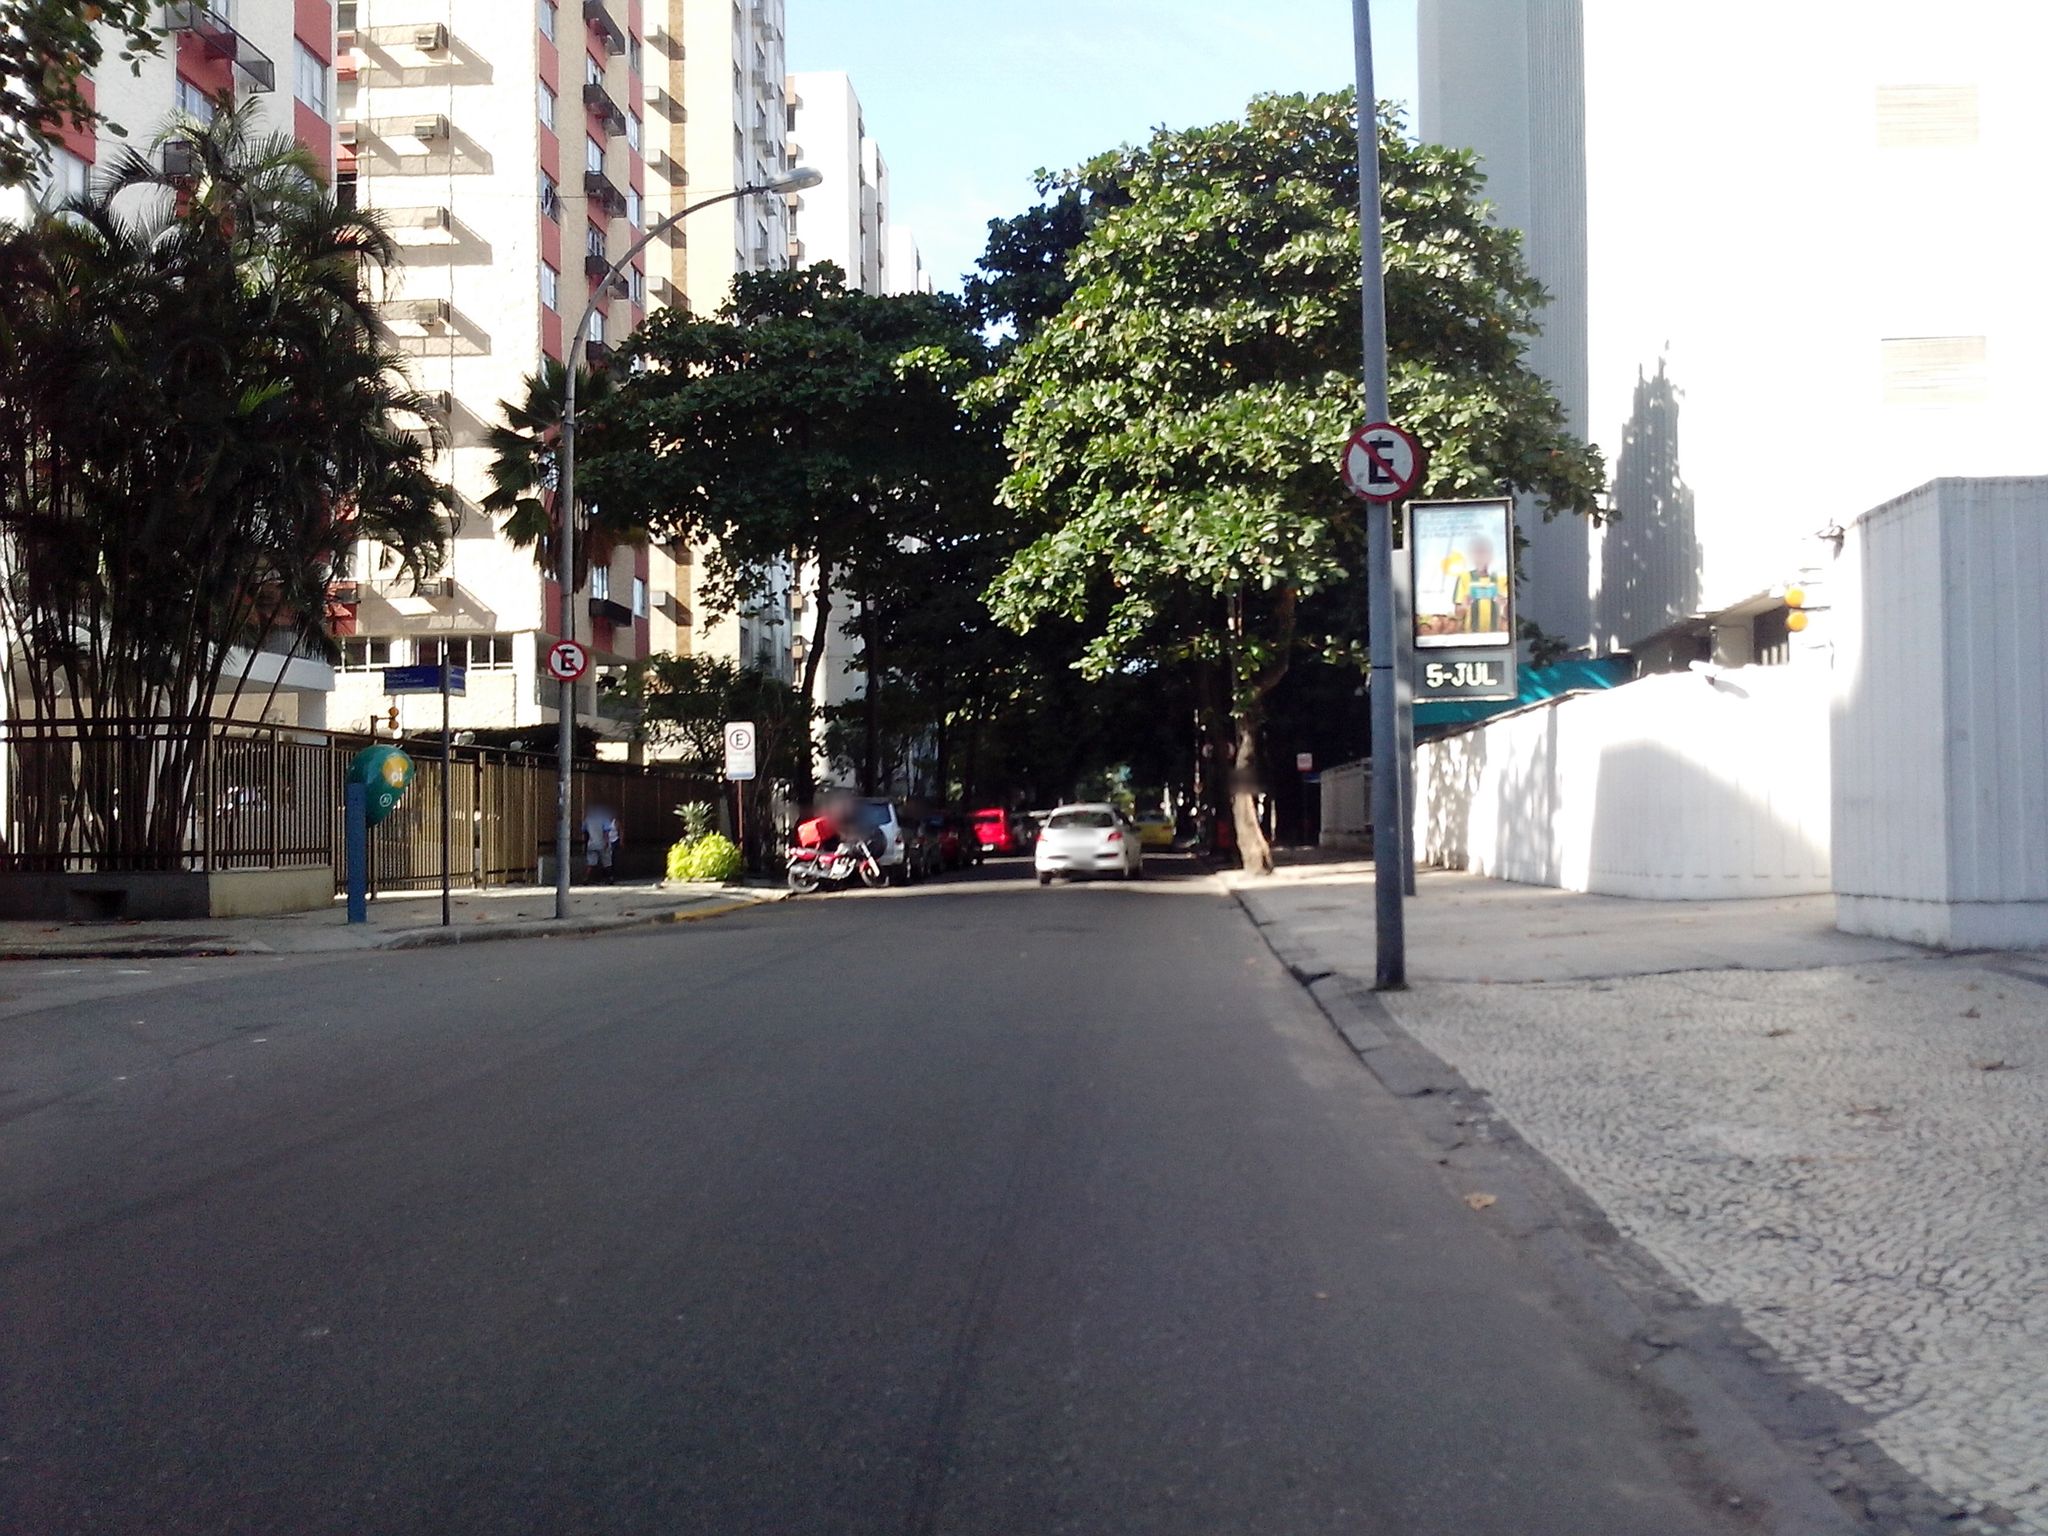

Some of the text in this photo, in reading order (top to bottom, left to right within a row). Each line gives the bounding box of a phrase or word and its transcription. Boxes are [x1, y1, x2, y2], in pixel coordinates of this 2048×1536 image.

[1368, 440, 1394, 484] E
[560, 648, 575, 671] E
[1426, 662, 1498, 688] 5-JUL
[735, 733, 744, 746] E
